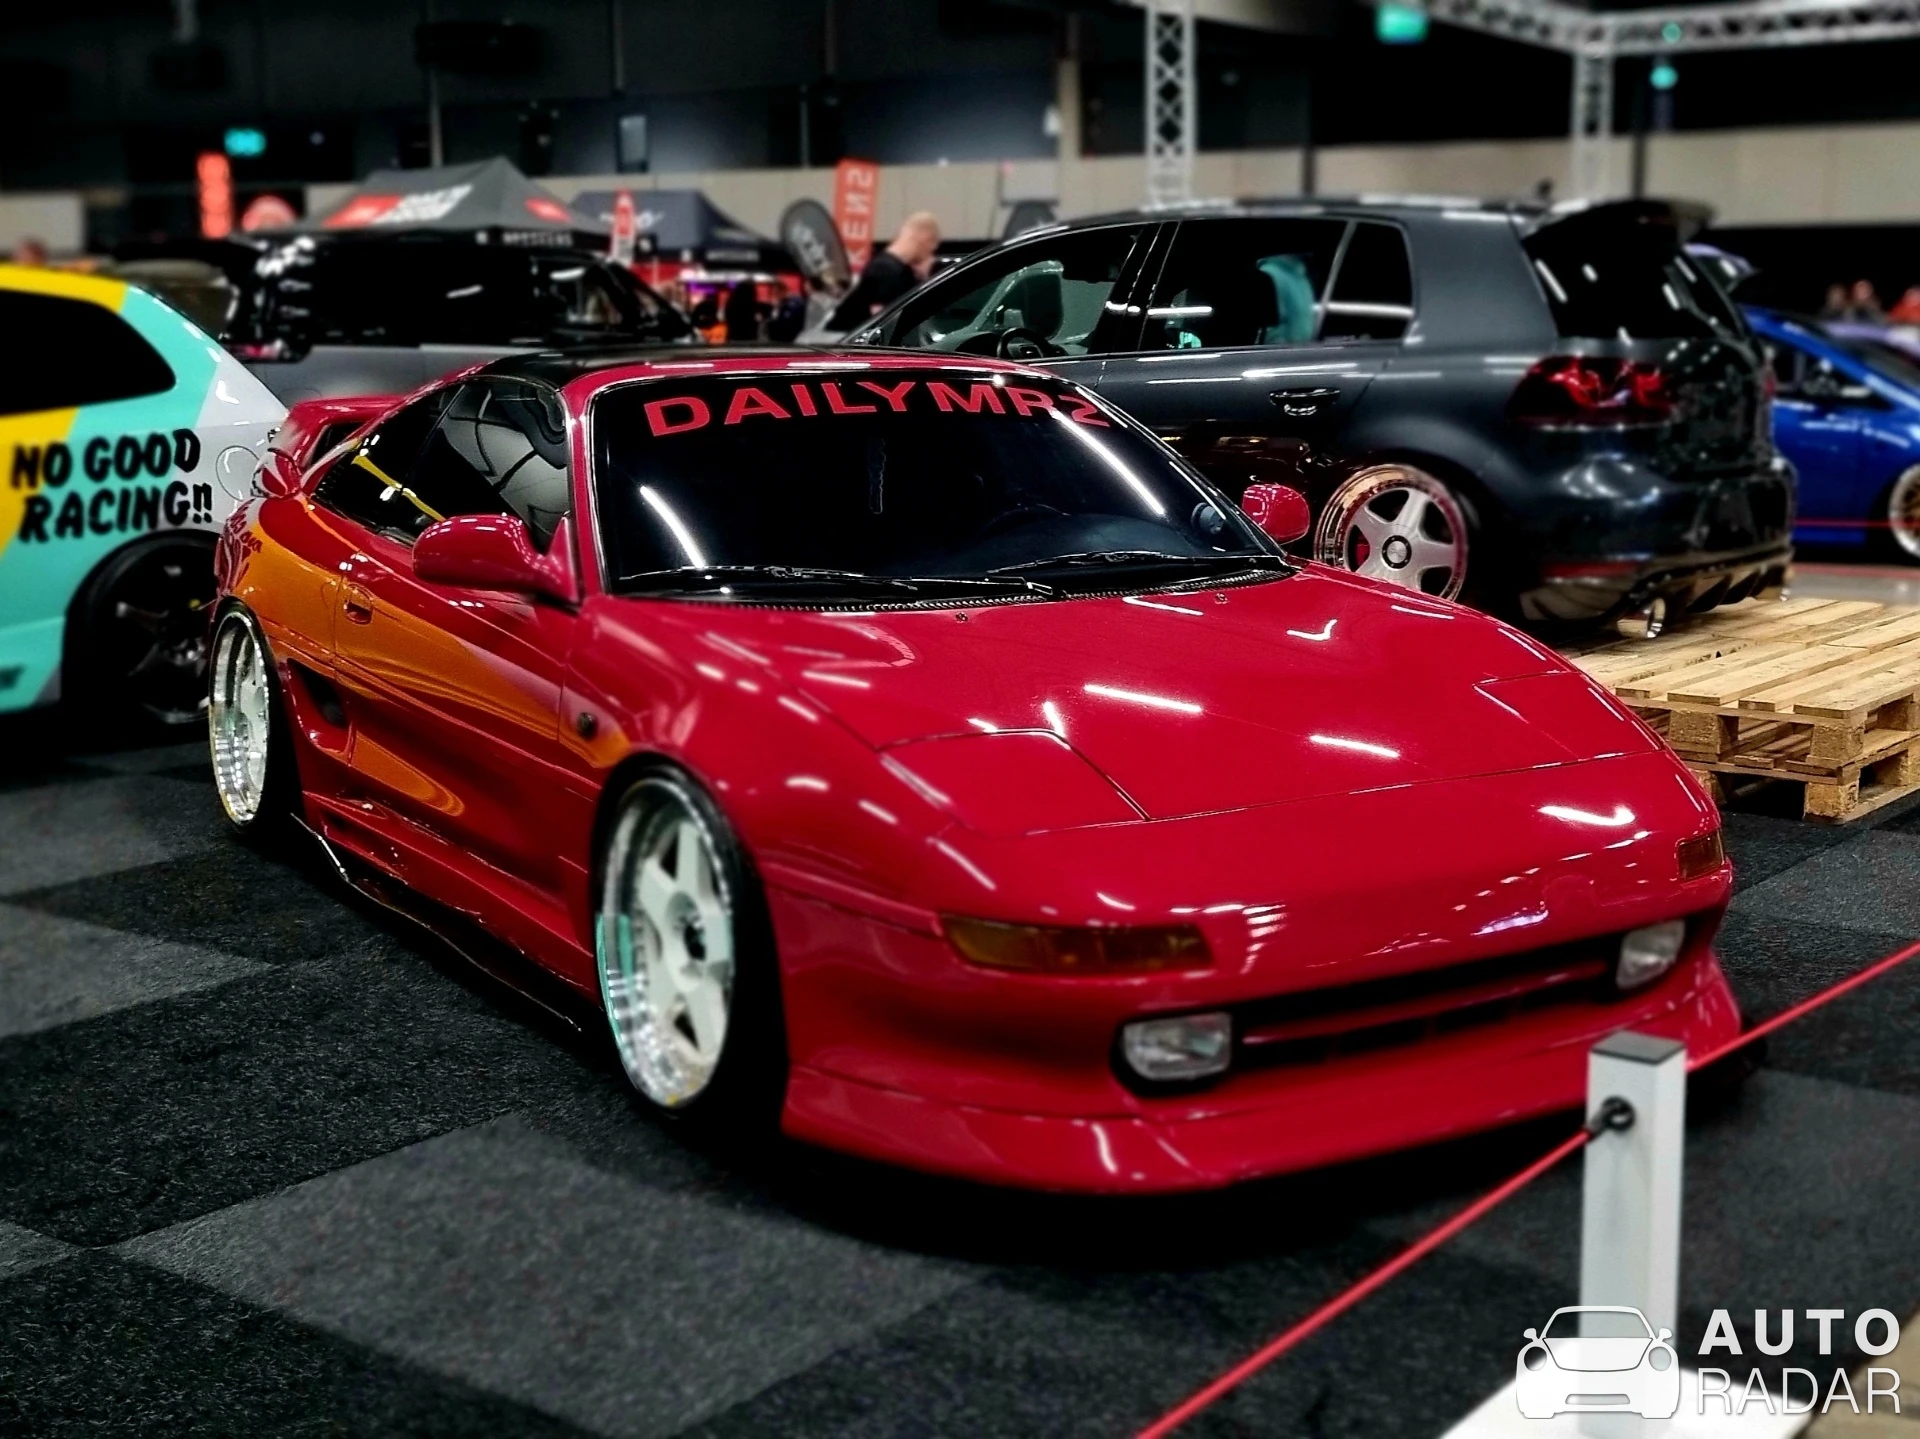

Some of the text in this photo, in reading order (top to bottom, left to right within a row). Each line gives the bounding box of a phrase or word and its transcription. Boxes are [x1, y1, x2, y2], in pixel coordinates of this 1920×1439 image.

[643, 381, 1110, 437] DAILYMR2
[11, 428, 201, 488] NO GOOD
[19, 481, 212, 542] RACING!!
